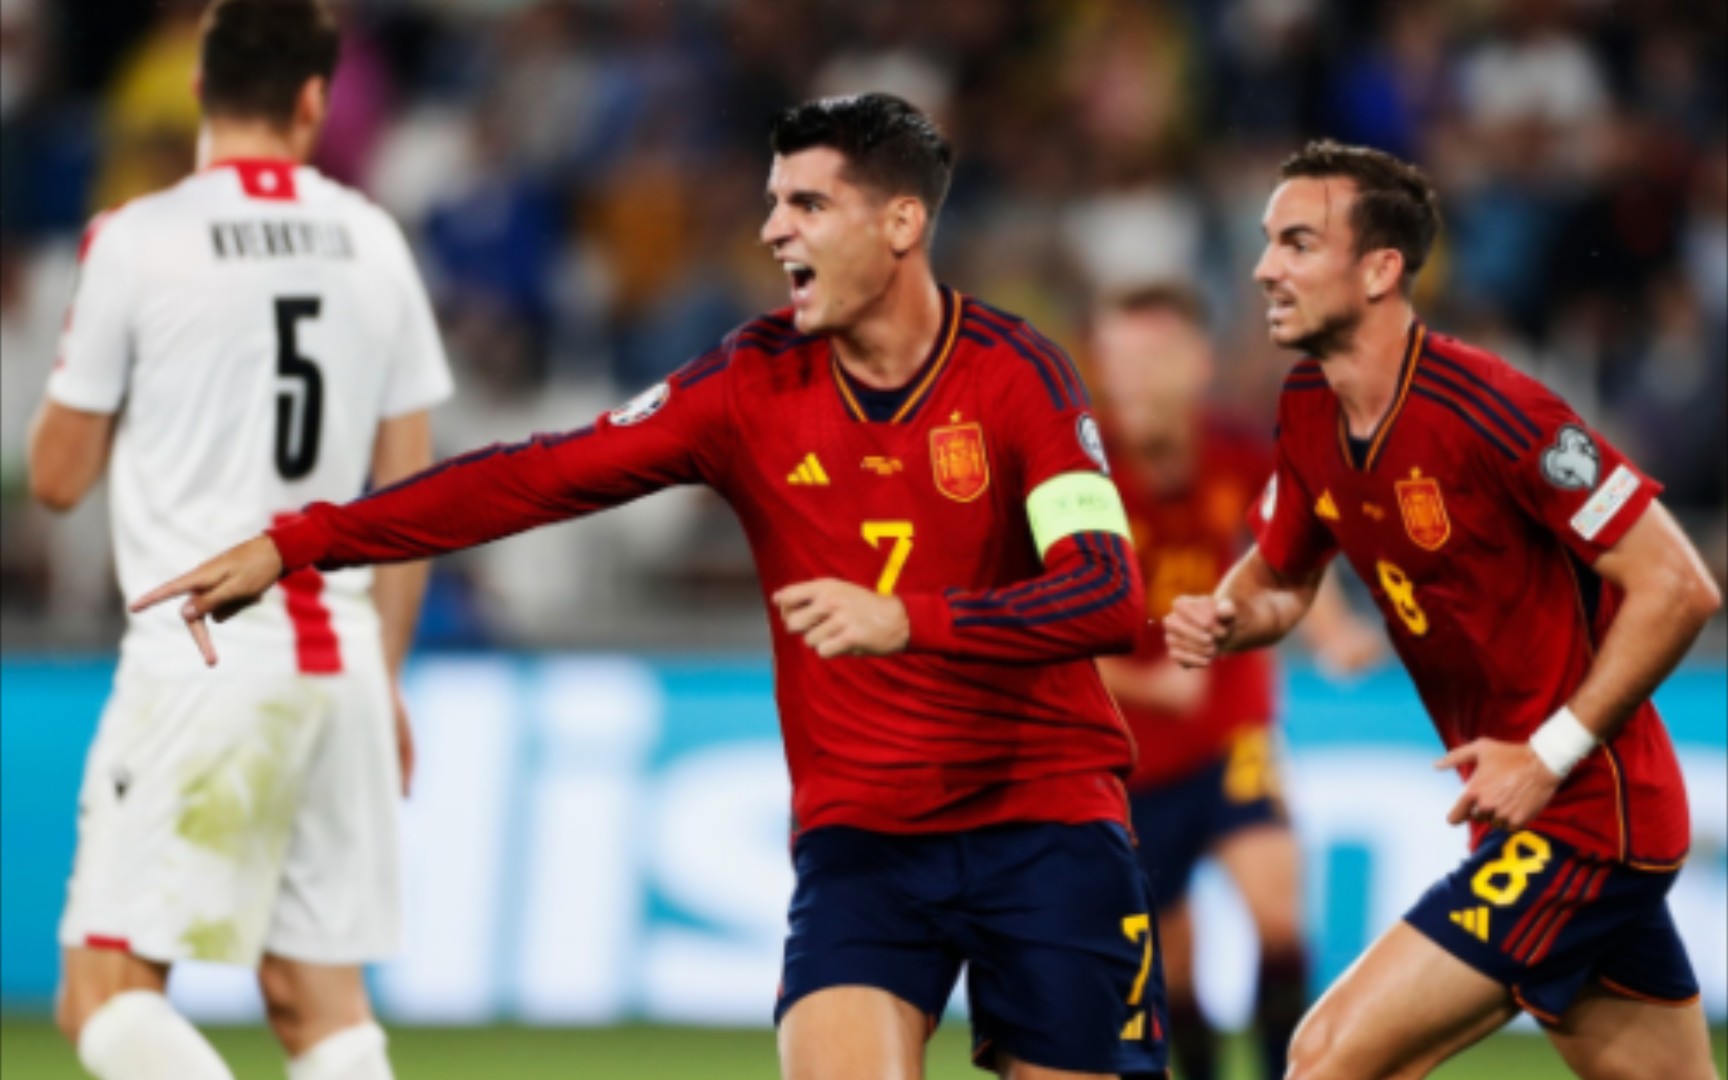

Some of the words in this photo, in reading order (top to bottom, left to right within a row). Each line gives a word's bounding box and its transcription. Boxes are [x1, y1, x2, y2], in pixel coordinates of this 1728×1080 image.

[273, 296, 323, 482] 5
[861, 519, 914, 598] 7
[1376, 559, 1428, 636] 8
[1470, 829, 1551, 905] 8
[1120, 912, 1153, 1006] 7
